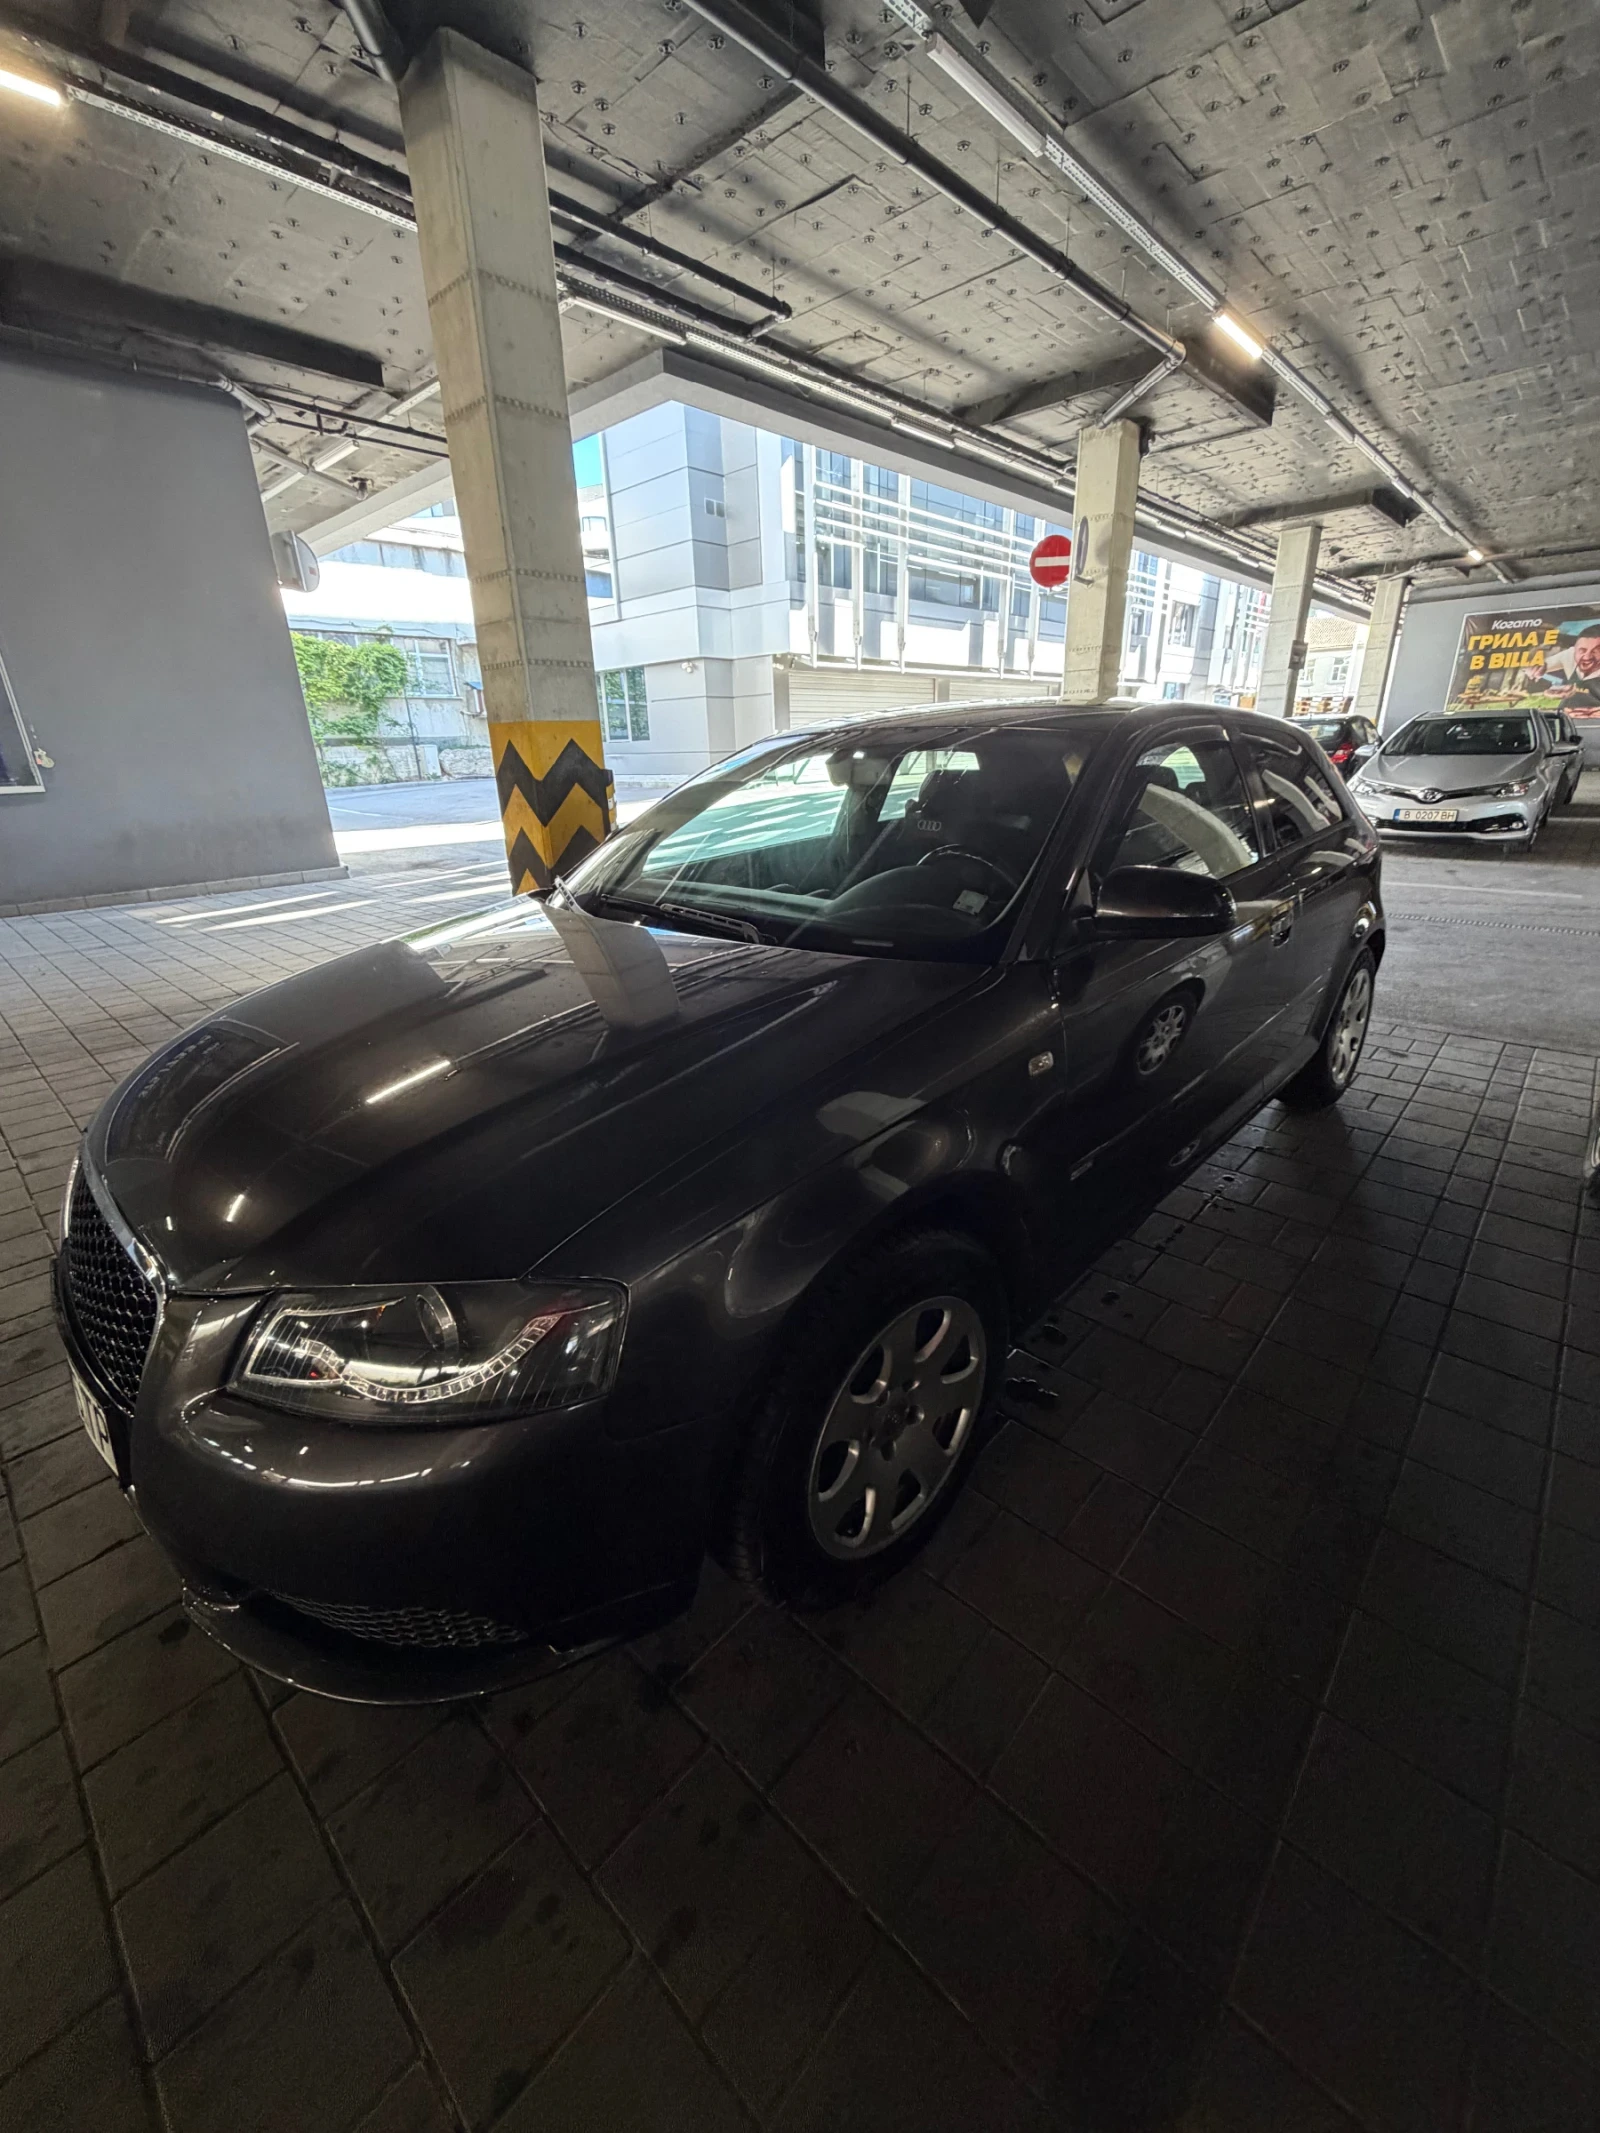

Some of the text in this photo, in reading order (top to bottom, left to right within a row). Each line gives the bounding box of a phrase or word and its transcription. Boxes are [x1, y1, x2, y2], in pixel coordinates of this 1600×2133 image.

[1491, 618, 1543, 631] Когато
[1467, 629, 1560, 651] ГРИЛА Е
[1469, 650, 1545, 670] В BILLA
[1415, 811, 1440, 820] 0207
